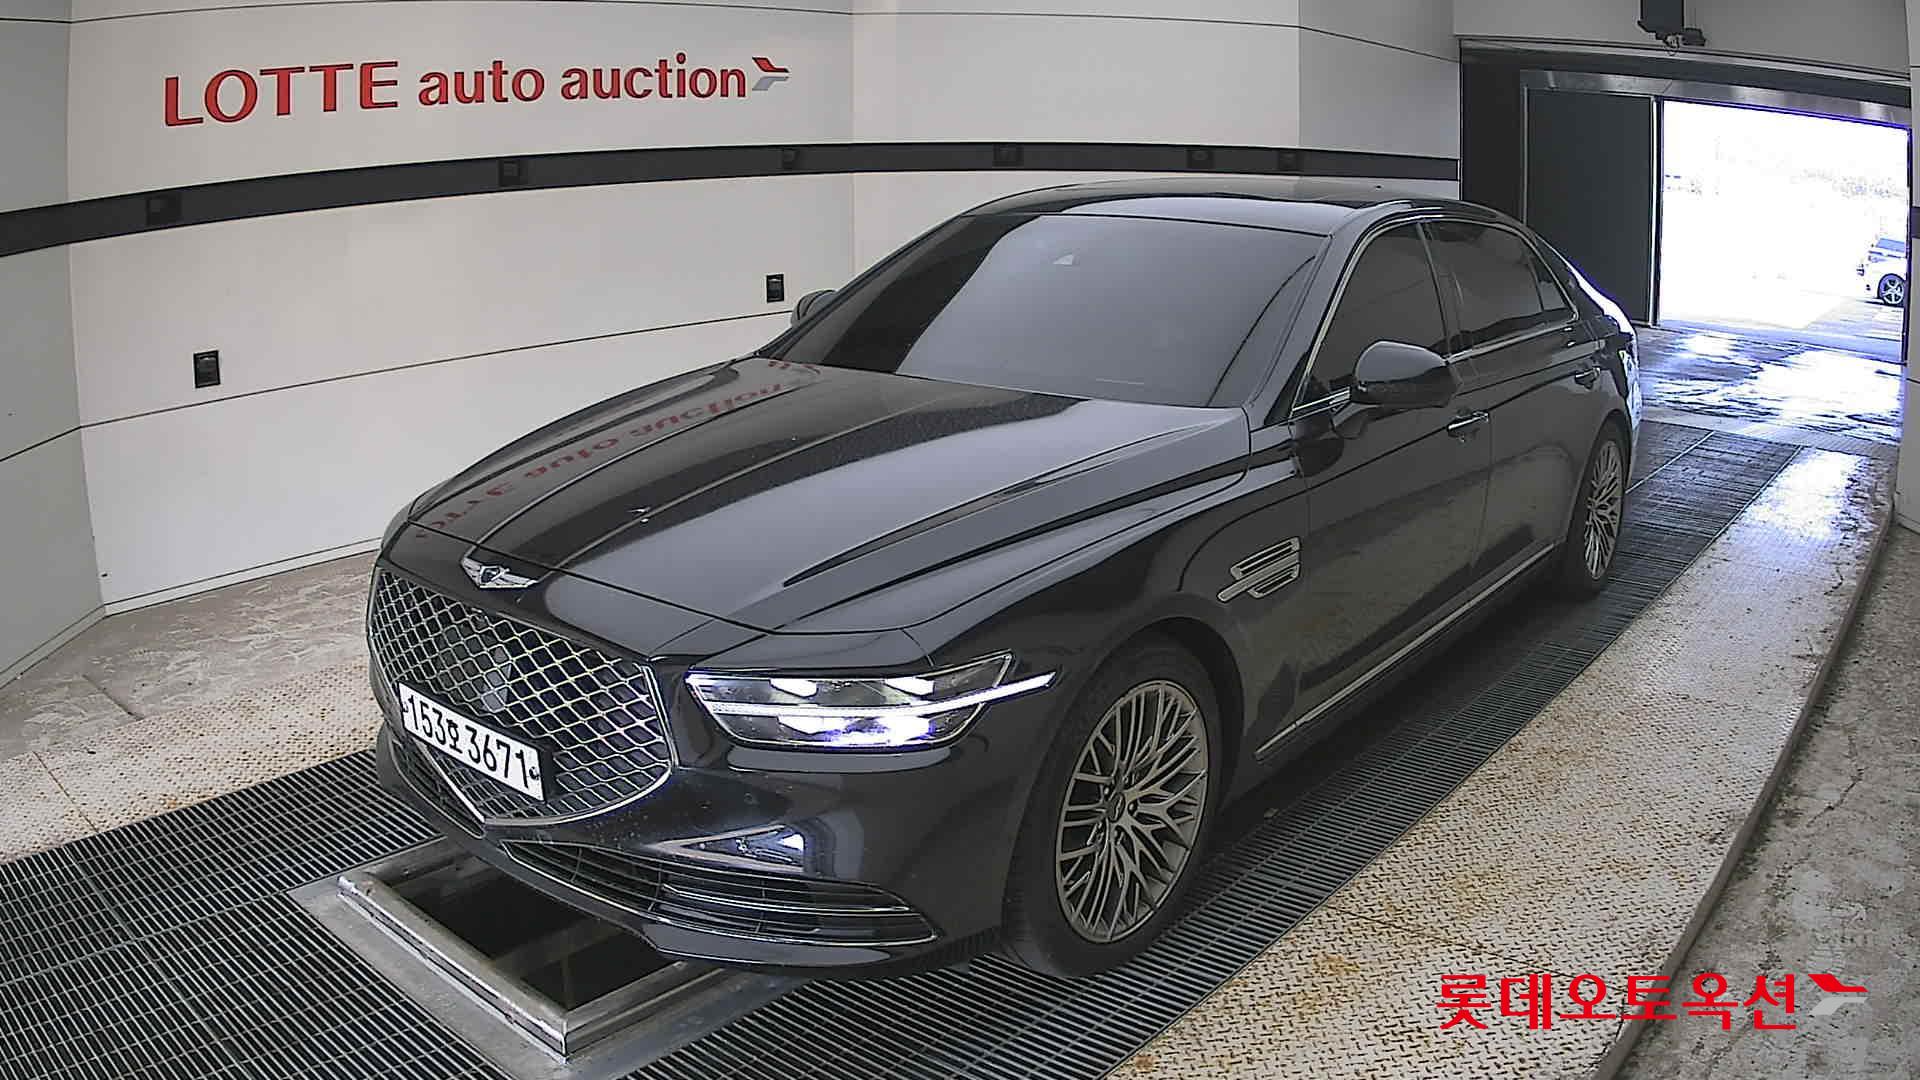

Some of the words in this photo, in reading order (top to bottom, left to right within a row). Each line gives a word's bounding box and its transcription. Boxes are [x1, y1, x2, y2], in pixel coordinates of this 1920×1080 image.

[164, 62, 399, 127] LOTTE
[418, 60, 545, 107] auto
[560, 53, 747, 100] auction
[464, 724, 530, 790] 3671
